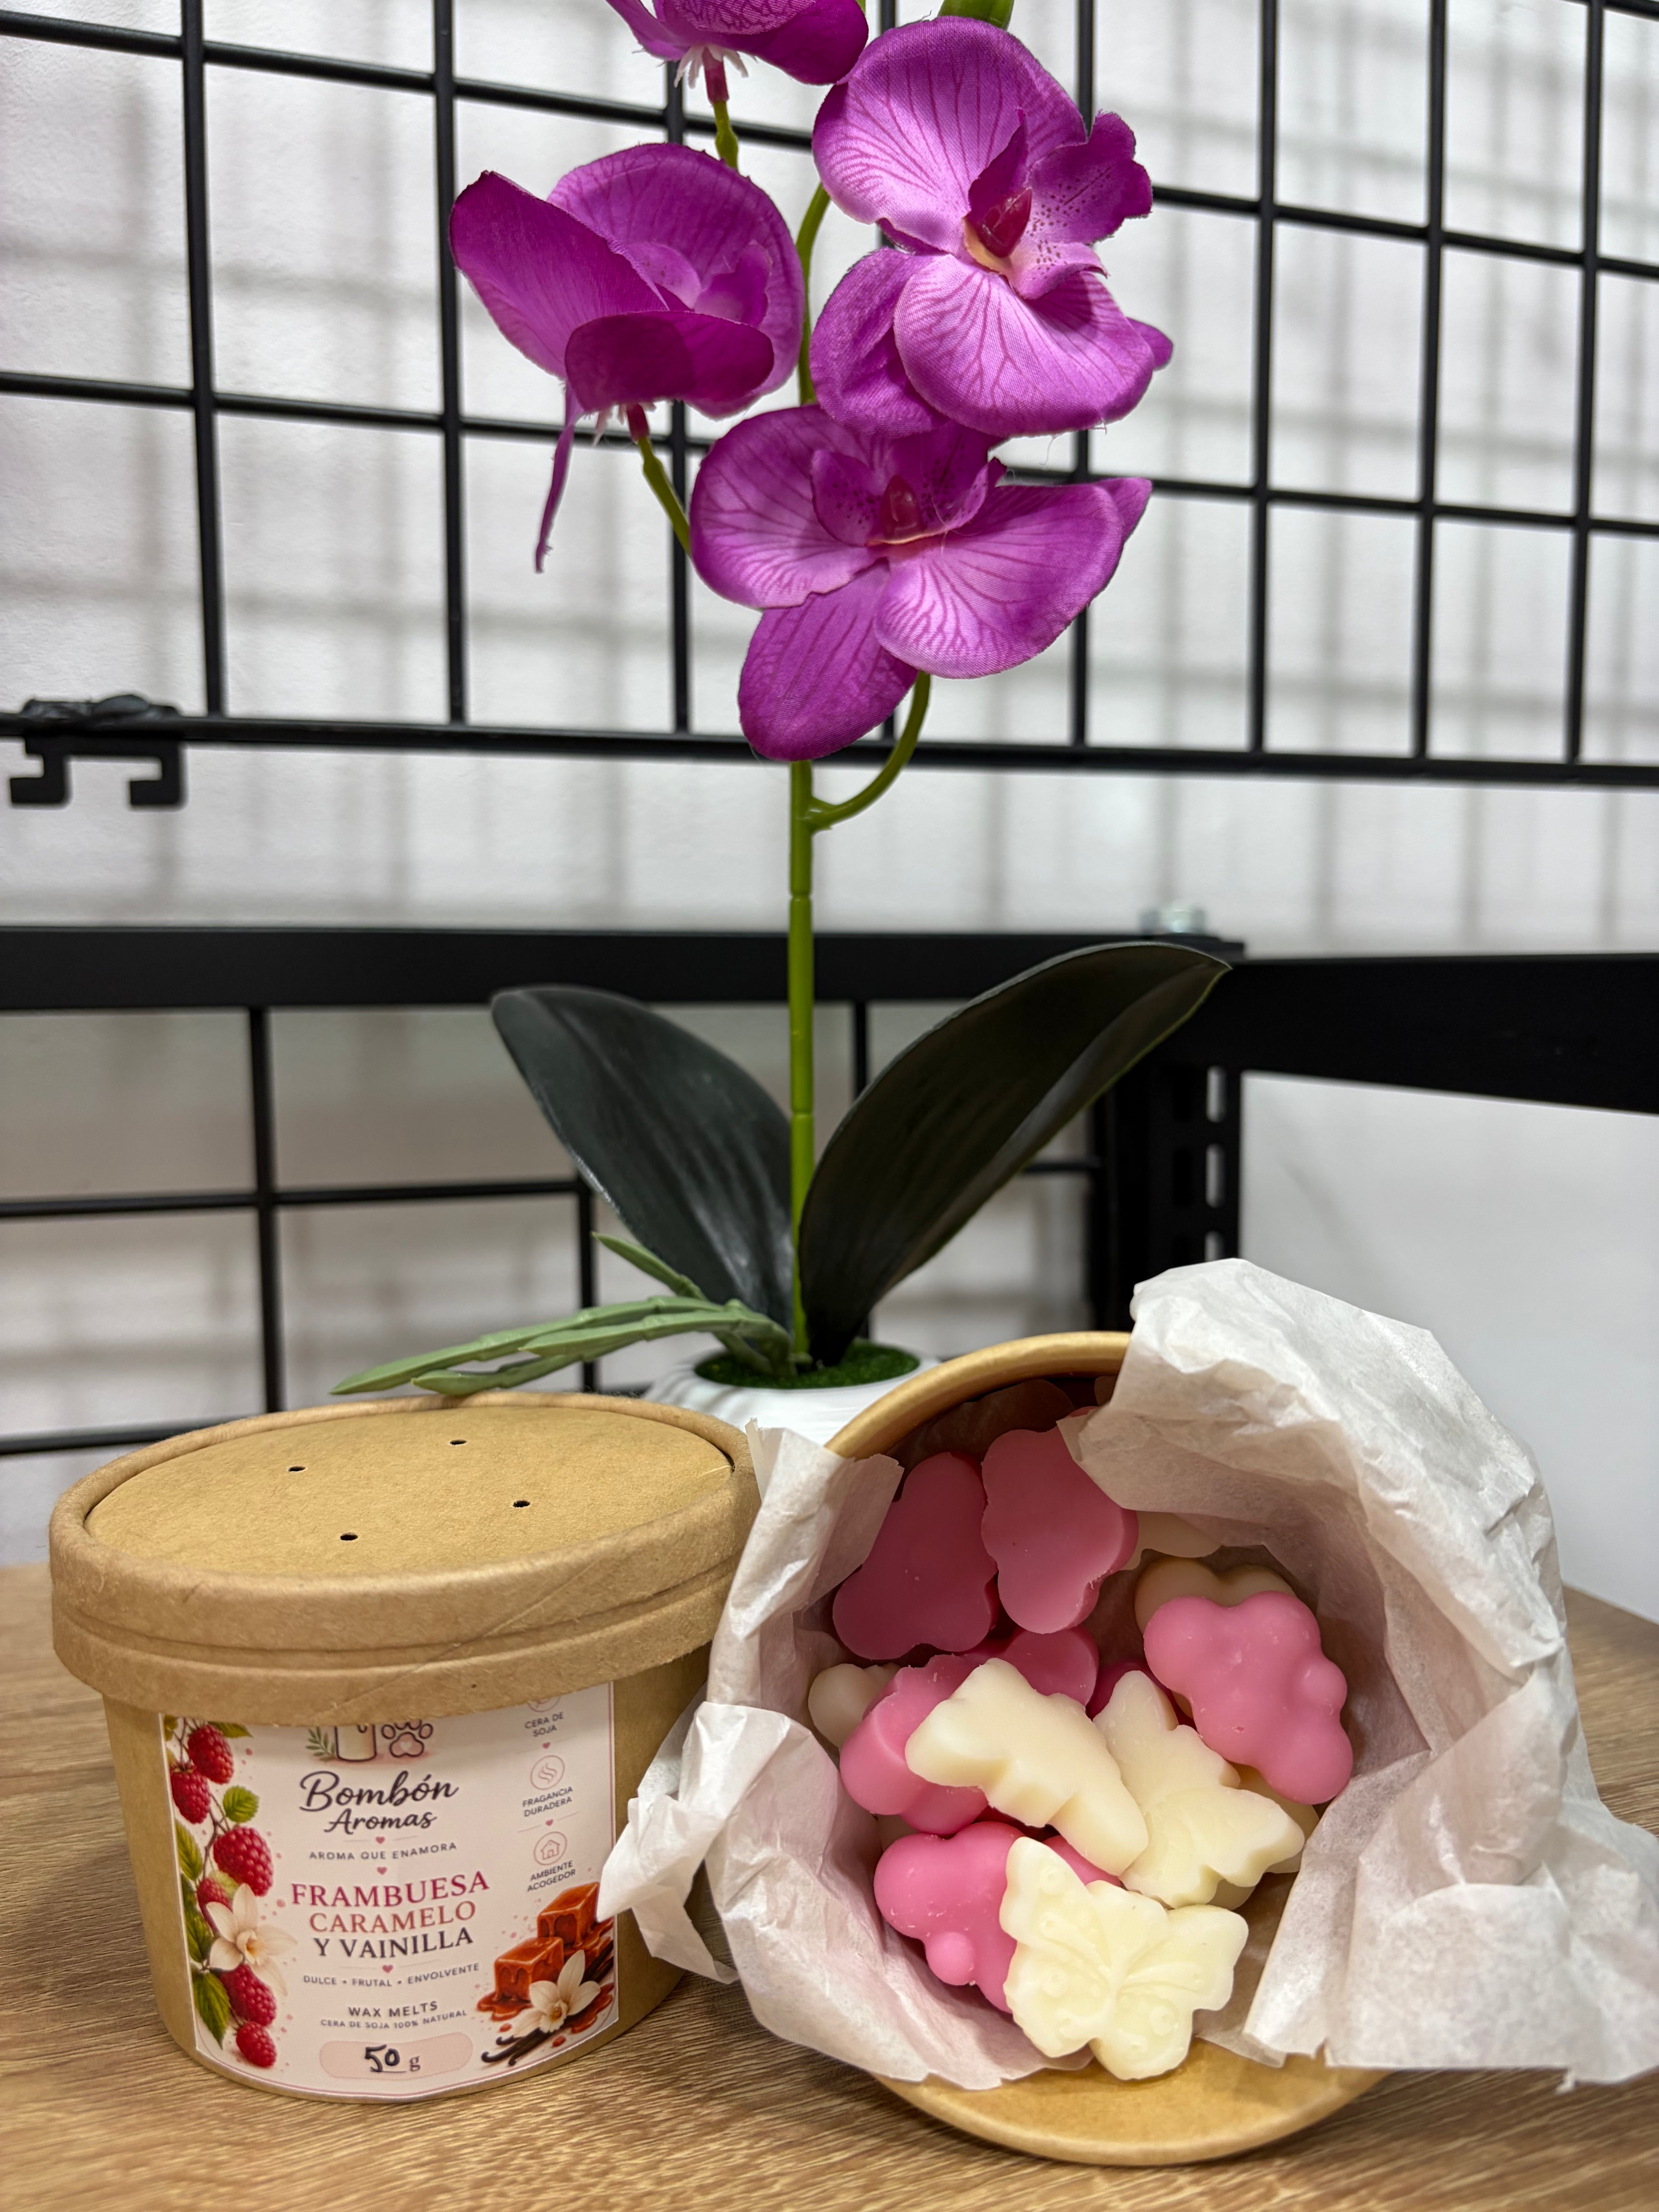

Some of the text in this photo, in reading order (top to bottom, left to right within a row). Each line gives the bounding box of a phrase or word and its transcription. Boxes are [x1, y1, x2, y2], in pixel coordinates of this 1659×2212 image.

[524, 1712, 563, 1729] CERA DE
[533, 1725, 557, 1737] SOJA
[299, 1770, 459, 1812] Bombón
[522, 1786, 573, 1807] FRAGANCIA
[524, 1796, 572, 1817] DURADERA
[324, 1808, 437, 1834] Aromas
[309, 1842, 457, 1859] AROMA QUE ENAMORA
[527, 1869, 575, 1892] ACOGEDOR
[531, 1860, 573, 1881] AMBIENTE
[291, 1871, 490, 1907] FRAMBUESA
[310, 1901, 476, 1933] CARAMELO
[314, 1927, 474, 1958] Y VAINILLA
[304, 1963, 480, 1987] DULCE FRUTAL ENVOLVENTE
[321, 2019, 345, 2027] CERA
[394, 2021, 418, 2029] 100%
[423, 2010, 467, 2024] NATURAL
[348, 2001, 438, 2017] WAX MELTS
[365, 2044, 420, 2072] 50 g
